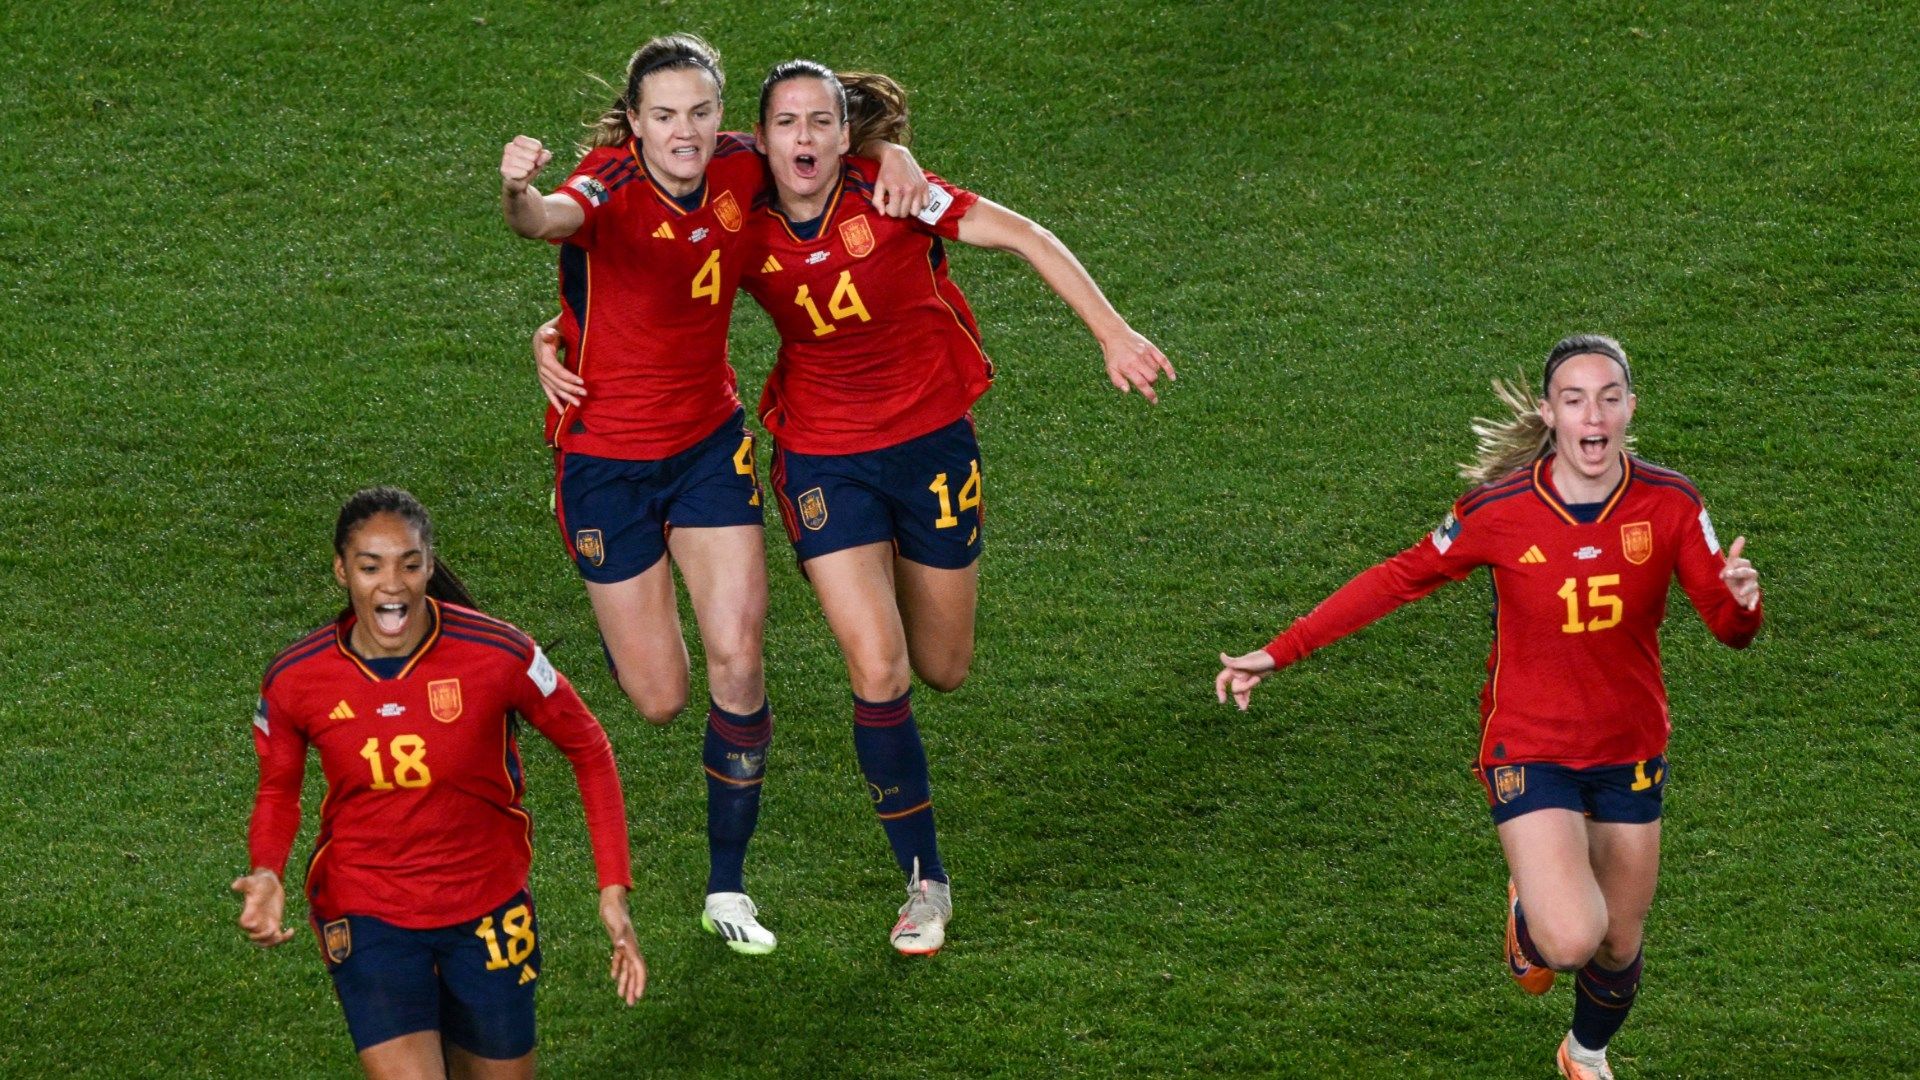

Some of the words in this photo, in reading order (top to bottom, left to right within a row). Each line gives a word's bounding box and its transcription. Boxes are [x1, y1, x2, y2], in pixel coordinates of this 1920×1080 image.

[691, 249, 720, 305] 4
[794, 270, 872, 336] 14
[733, 436, 755, 487] 4
[928, 459, 982, 529] 14
[1556, 573, 1623, 634] 15
[359, 734, 432, 790] 18
[1631, 760, 1664, 791] 1
[475, 904, 535, 971] 18
